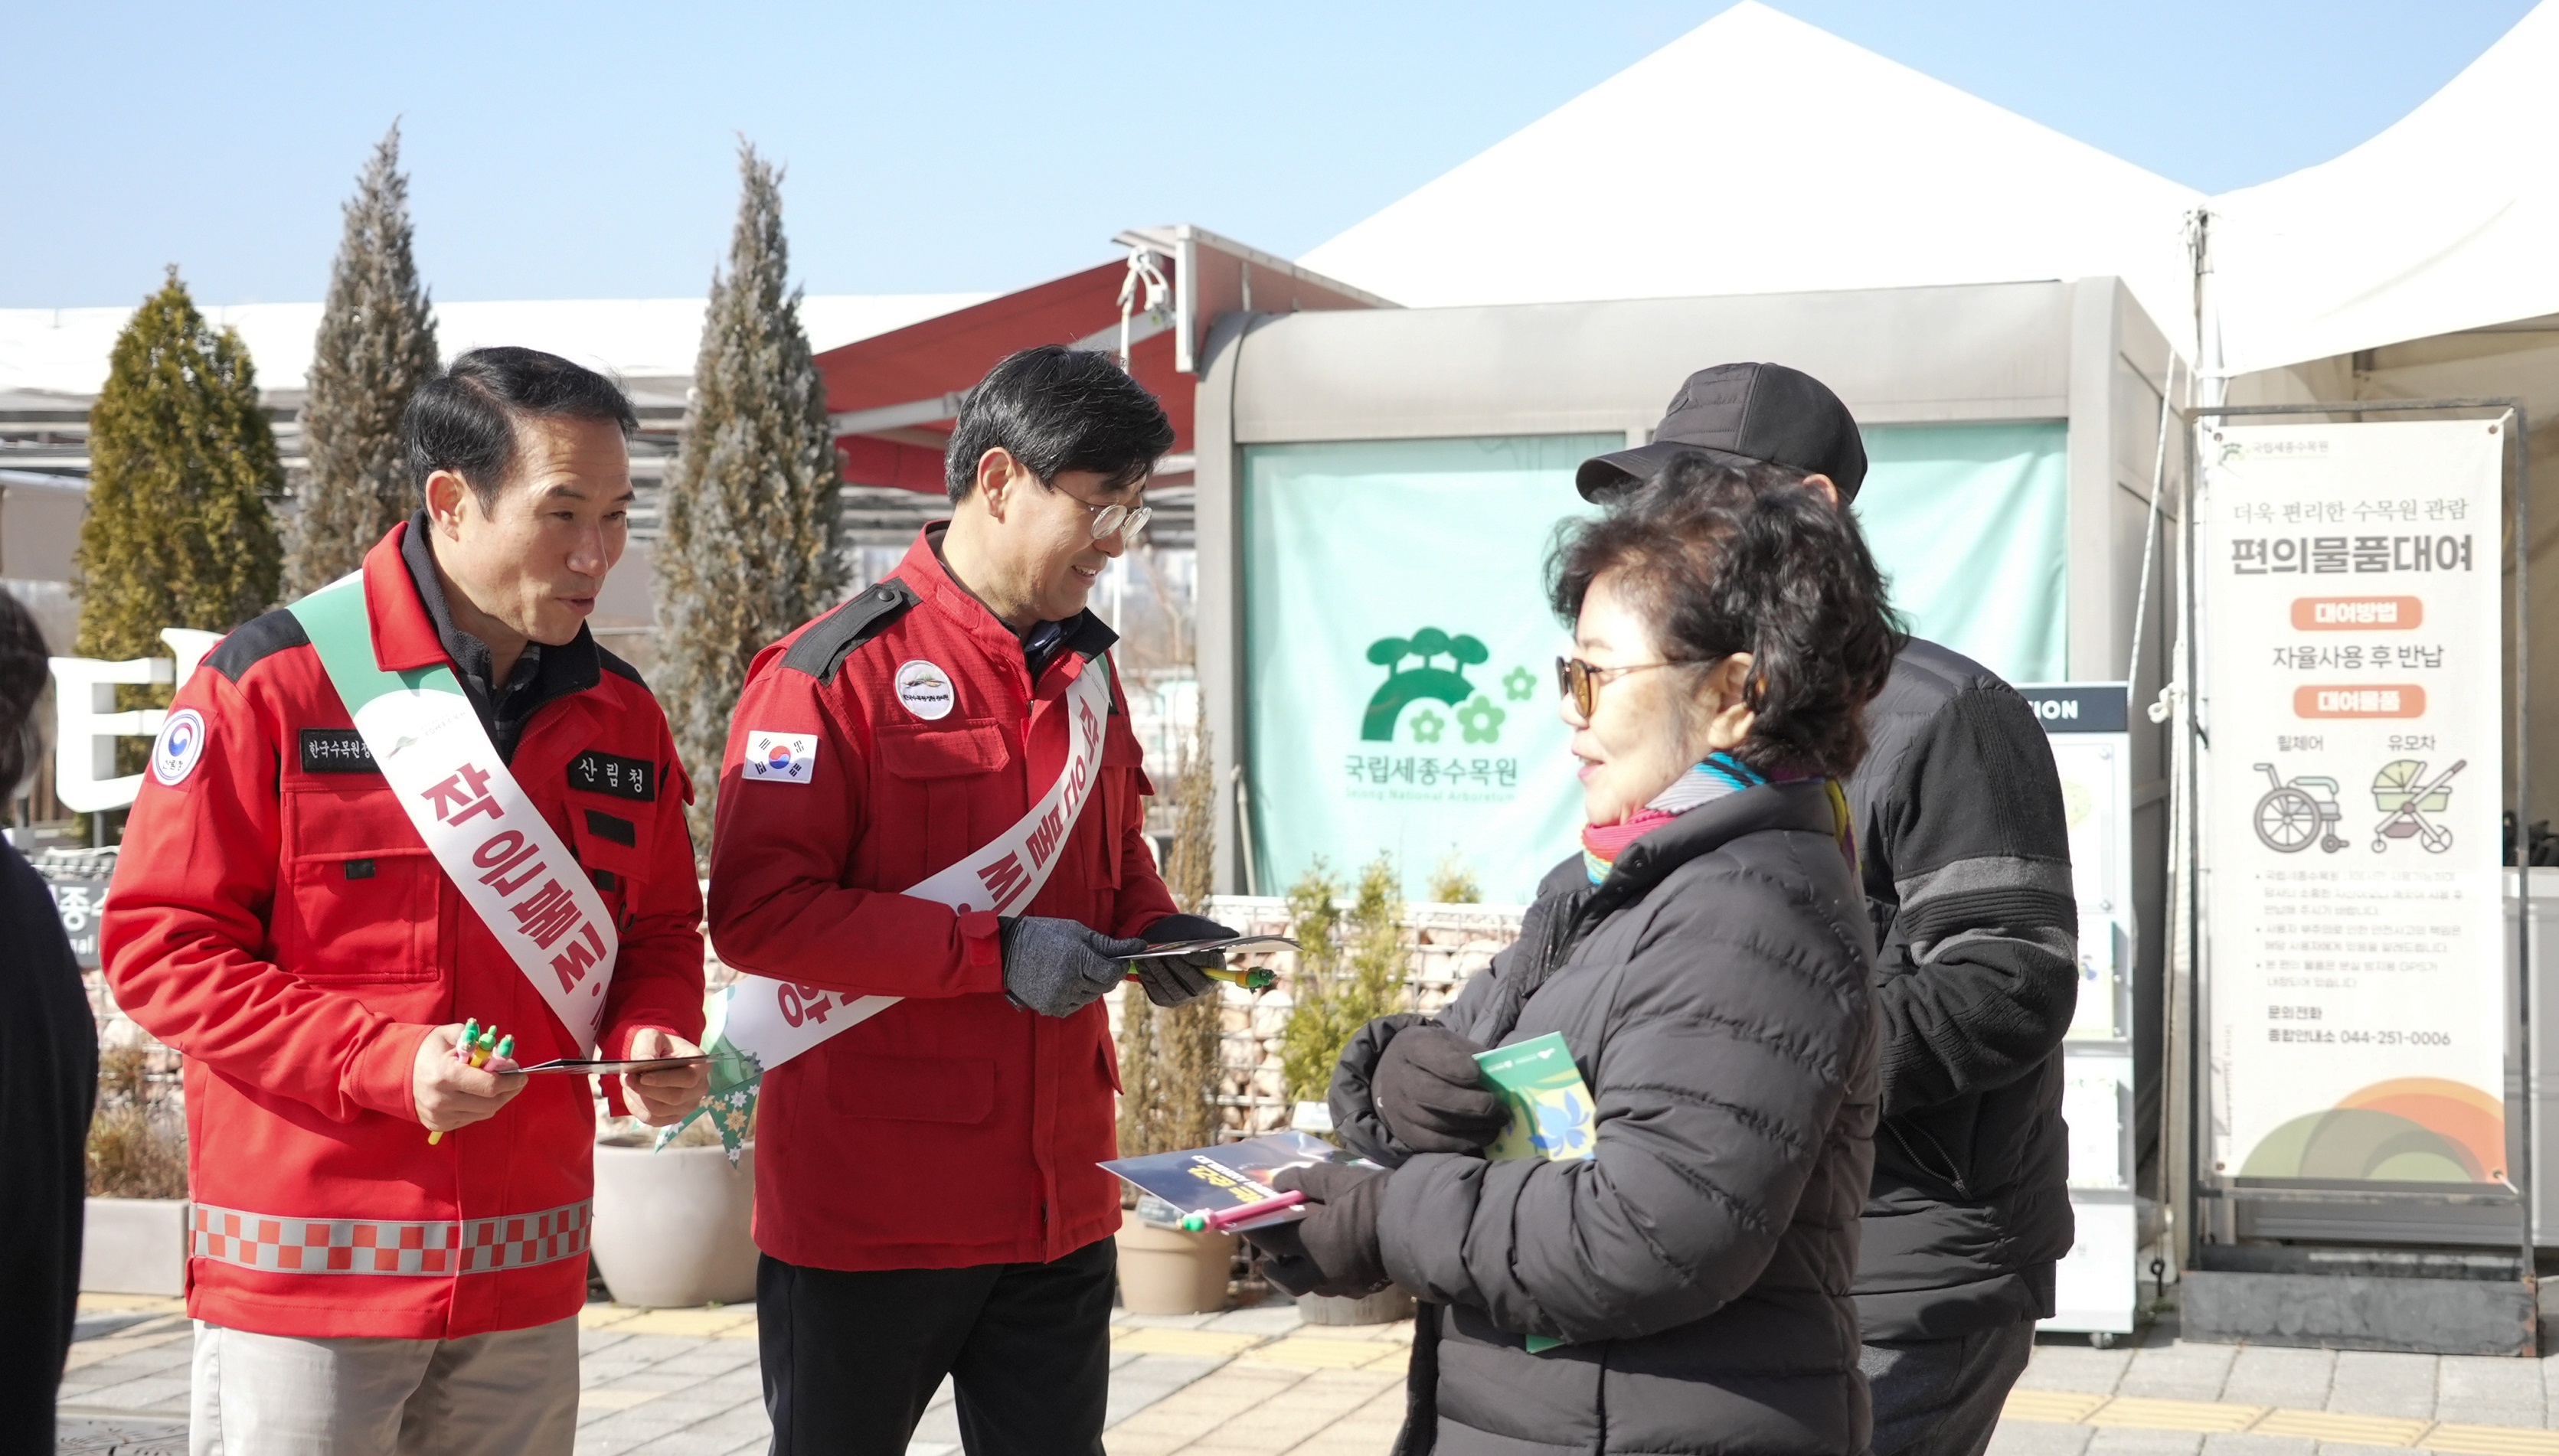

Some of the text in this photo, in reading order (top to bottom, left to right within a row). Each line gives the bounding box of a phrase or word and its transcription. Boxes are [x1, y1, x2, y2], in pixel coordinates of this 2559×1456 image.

[2234, 498, 2469, 524] 더욱 편리한 수목원 관람
[2231, 534, 2473, 575] 편의물품대여
[2315, 602, 2397, 623] 대여방법
[2273, 645, 2444, 670] 자율사용 후 반납
[2318, 690, 2401, 712] 대여물품
[2277, 735, 2324, 752] 휠체어
[2387, 735, 2436, 751] 유모차
[578, 757, 643, 793] 산림청
[1345, 755, 1518, 787] 국립세종수목원
[2268, 1006, 2322, 1020] 문의전화
[2268, 1028, 2451, 1046] 종합안내소 044-251-0006
